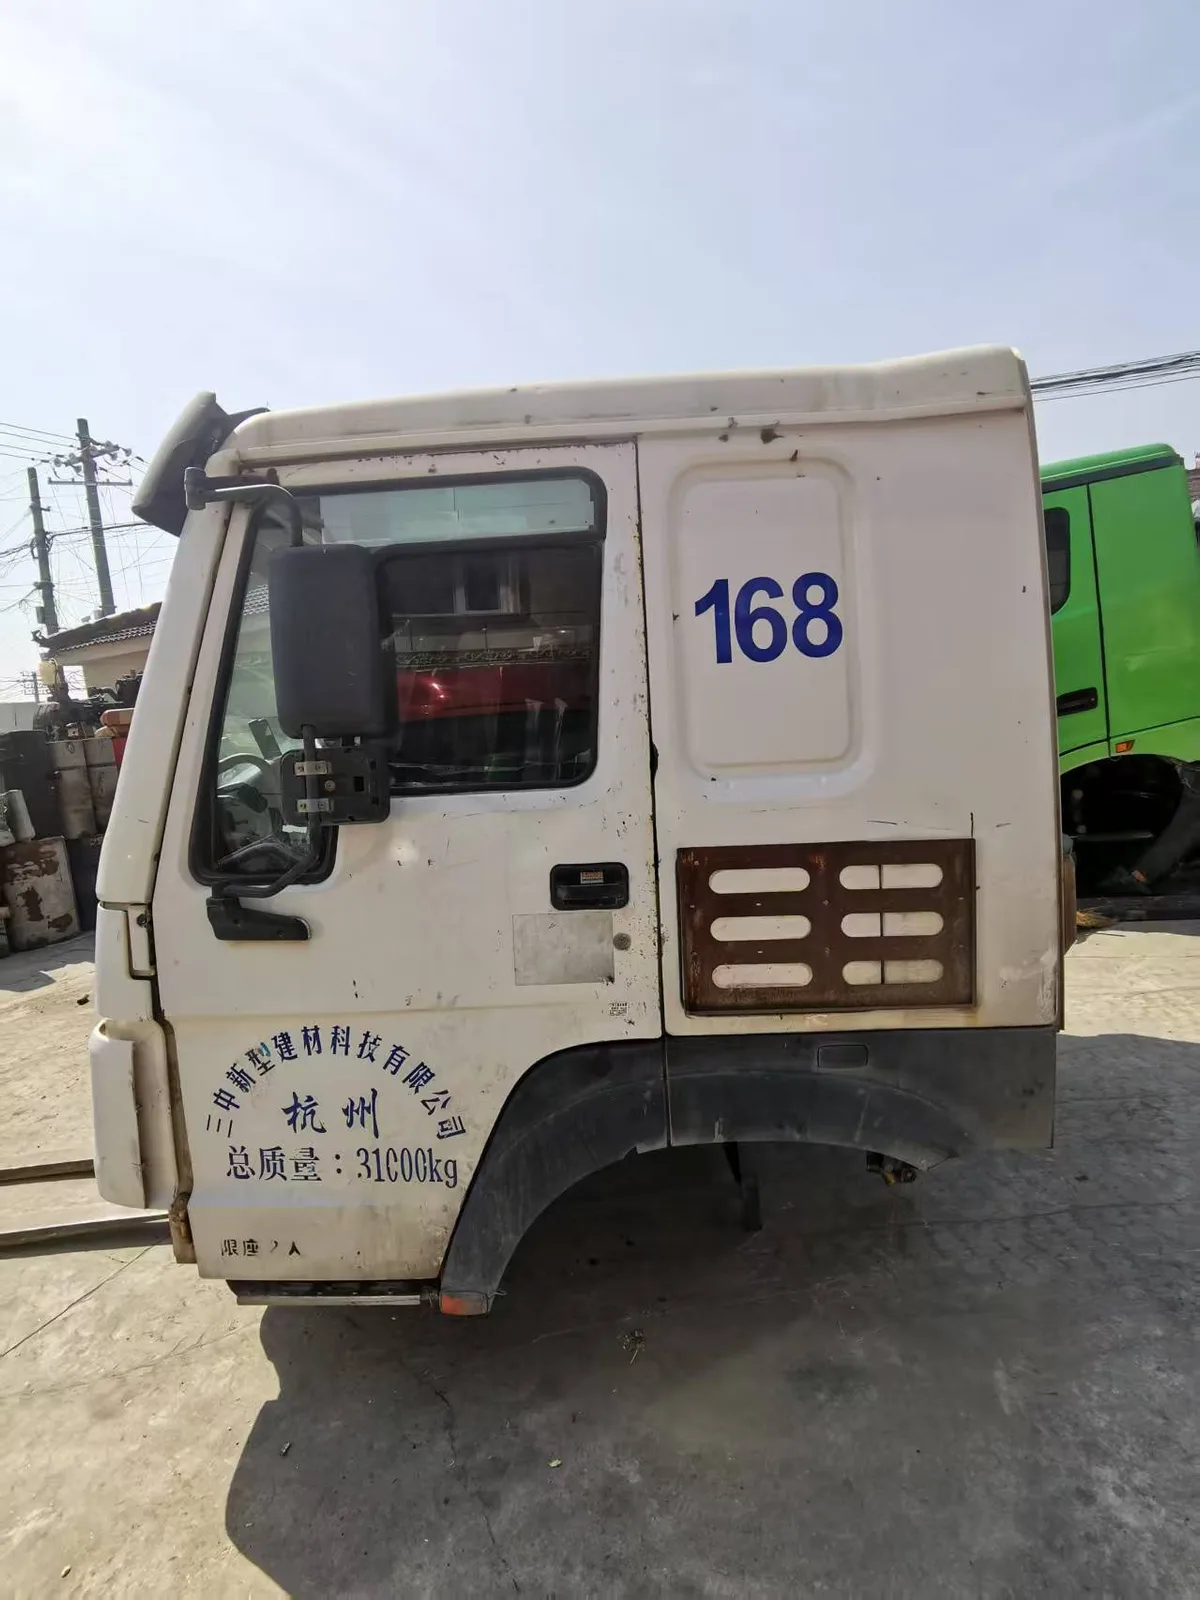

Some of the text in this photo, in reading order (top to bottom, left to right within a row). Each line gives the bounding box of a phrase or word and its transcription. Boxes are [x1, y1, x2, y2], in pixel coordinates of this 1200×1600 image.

[695, 572, 843, 664] 168
[206, 1025, 466, 1140] 三中新型建材科技有限公司
[281, 1088, 380, 1139] 杭州
